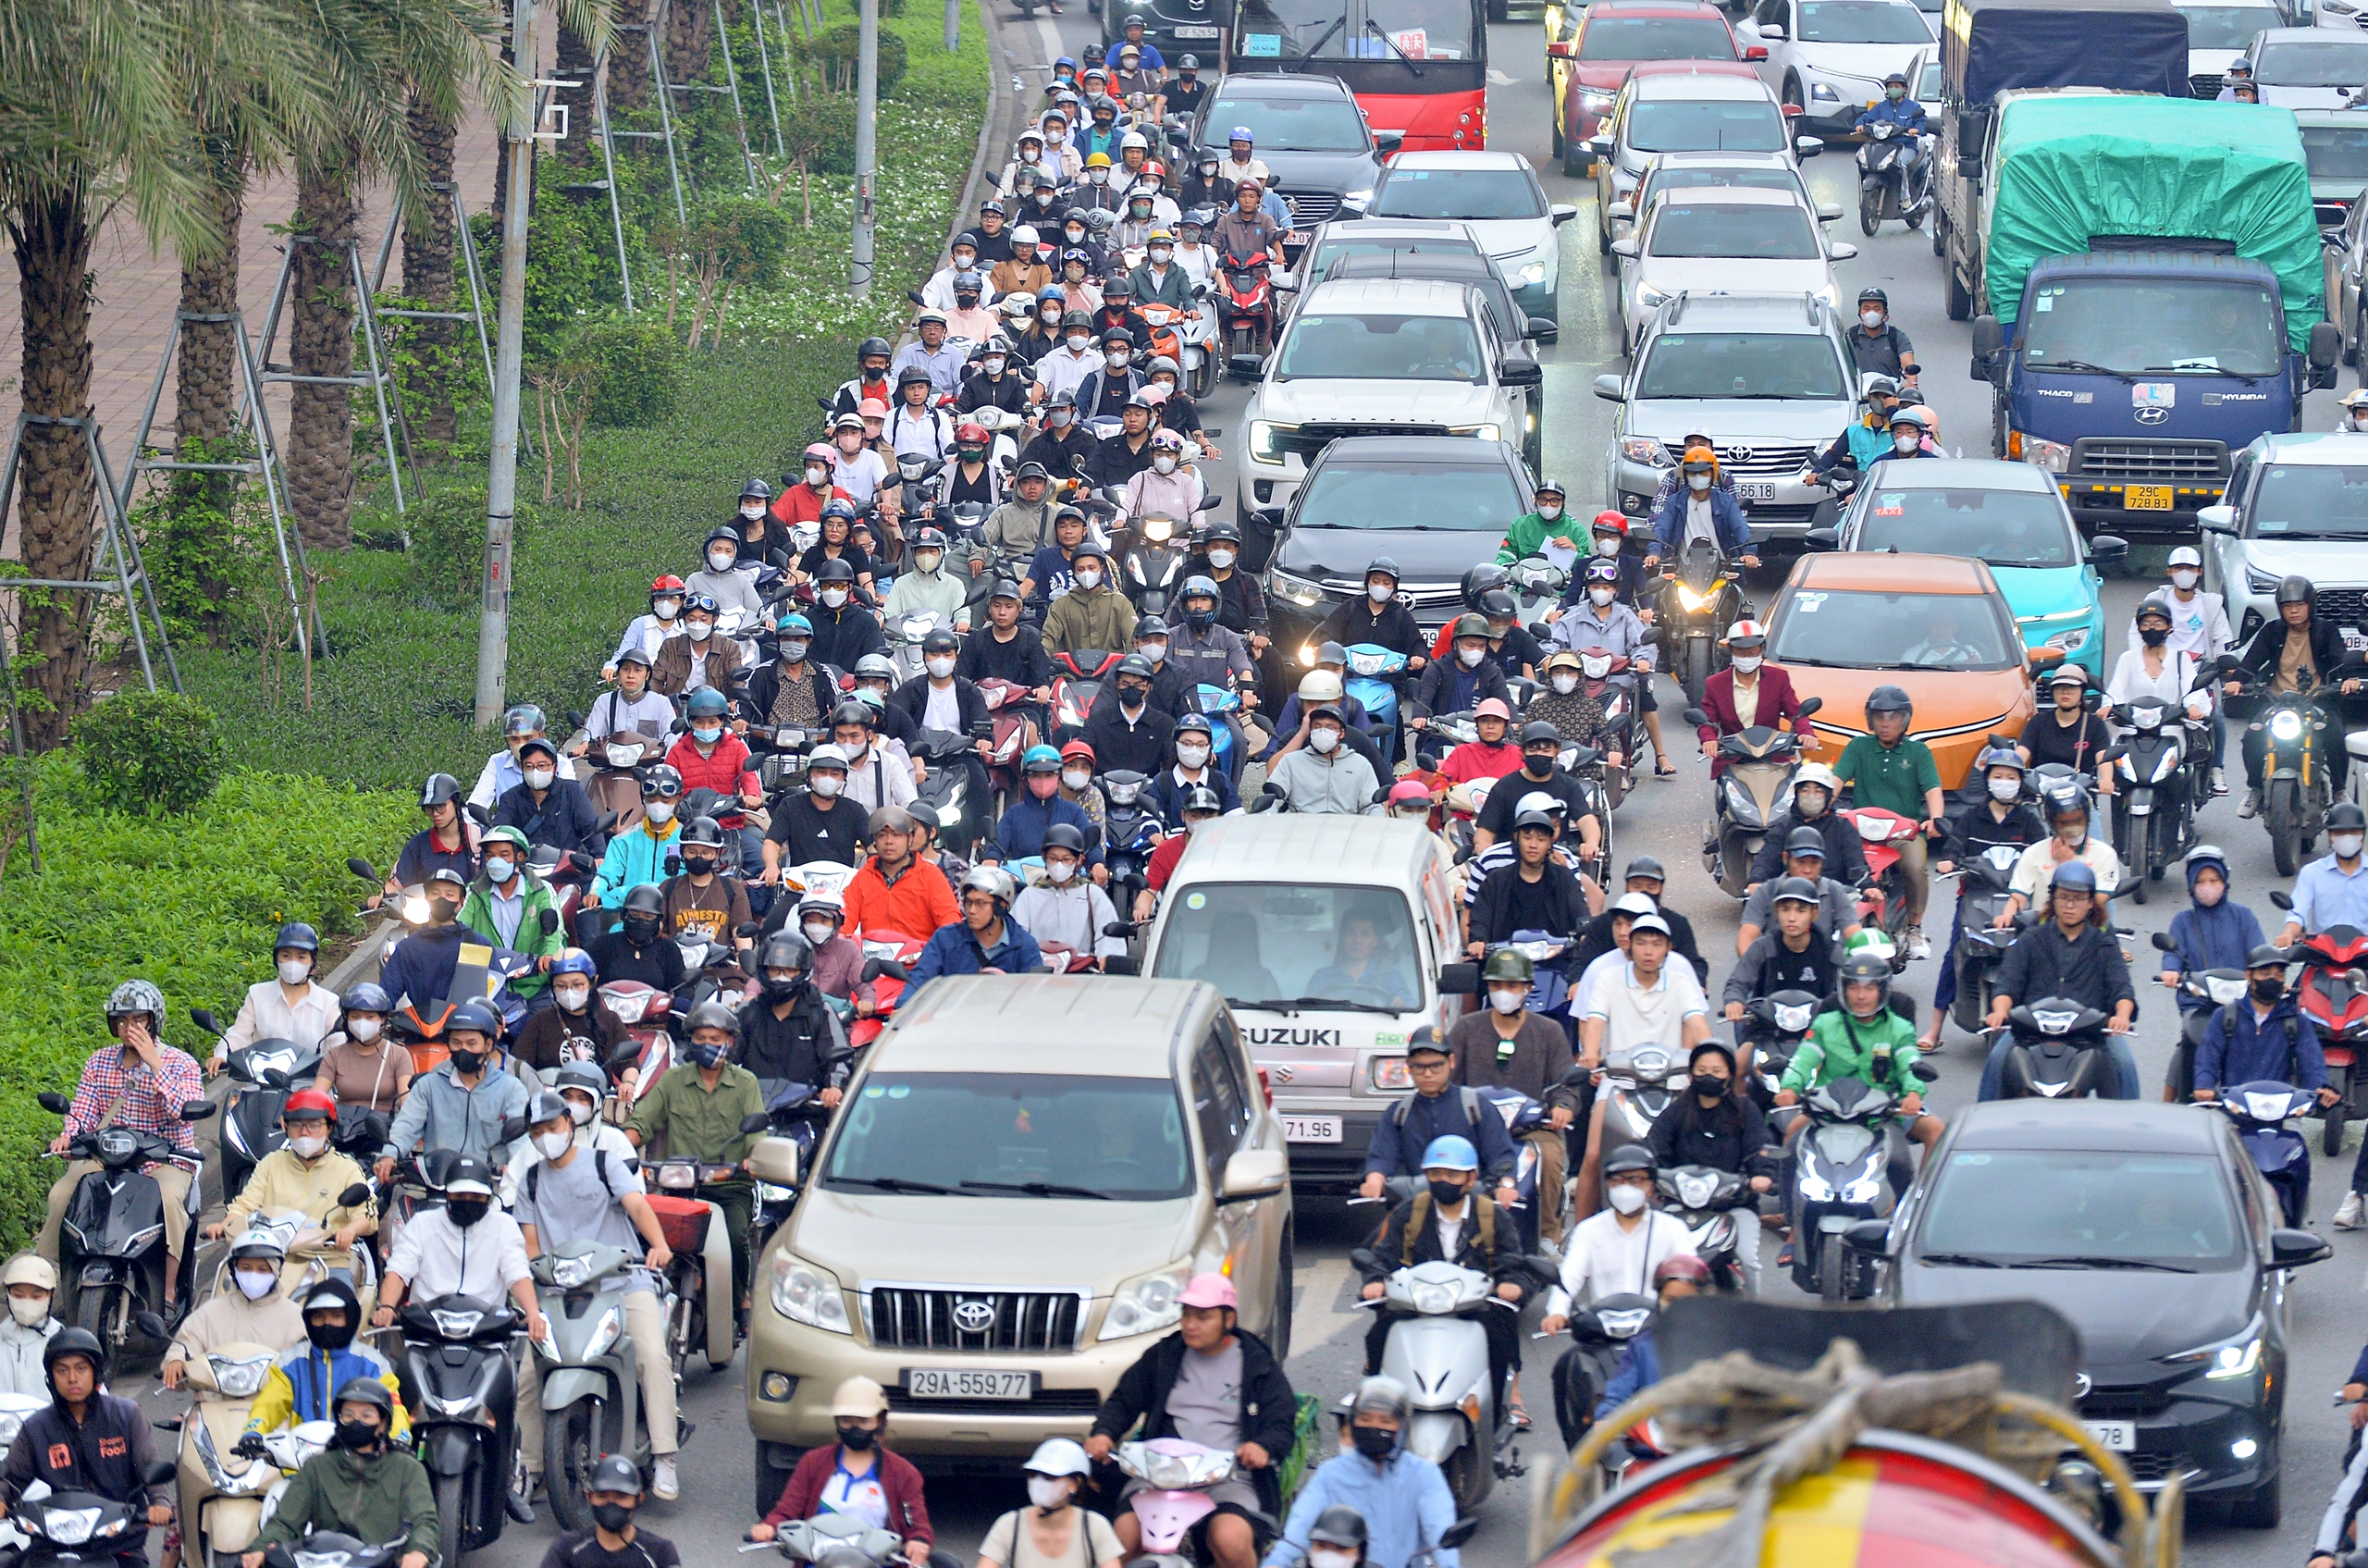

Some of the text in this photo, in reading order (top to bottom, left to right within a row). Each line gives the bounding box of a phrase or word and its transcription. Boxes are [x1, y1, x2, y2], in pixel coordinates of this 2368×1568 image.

[2037, 389, 2073, 398] THACO
[1741, 485, 1772, 498] 66.18
[2139, 487, 2160, 498] 29C
[2130, 497, 2168, 509] 728.83
[1874, 506, 1905, 516] TAXI
[1286, 1122, 1331, 1137] 71.96
[914, 1373, 1027, 1395] 29A-559.77
